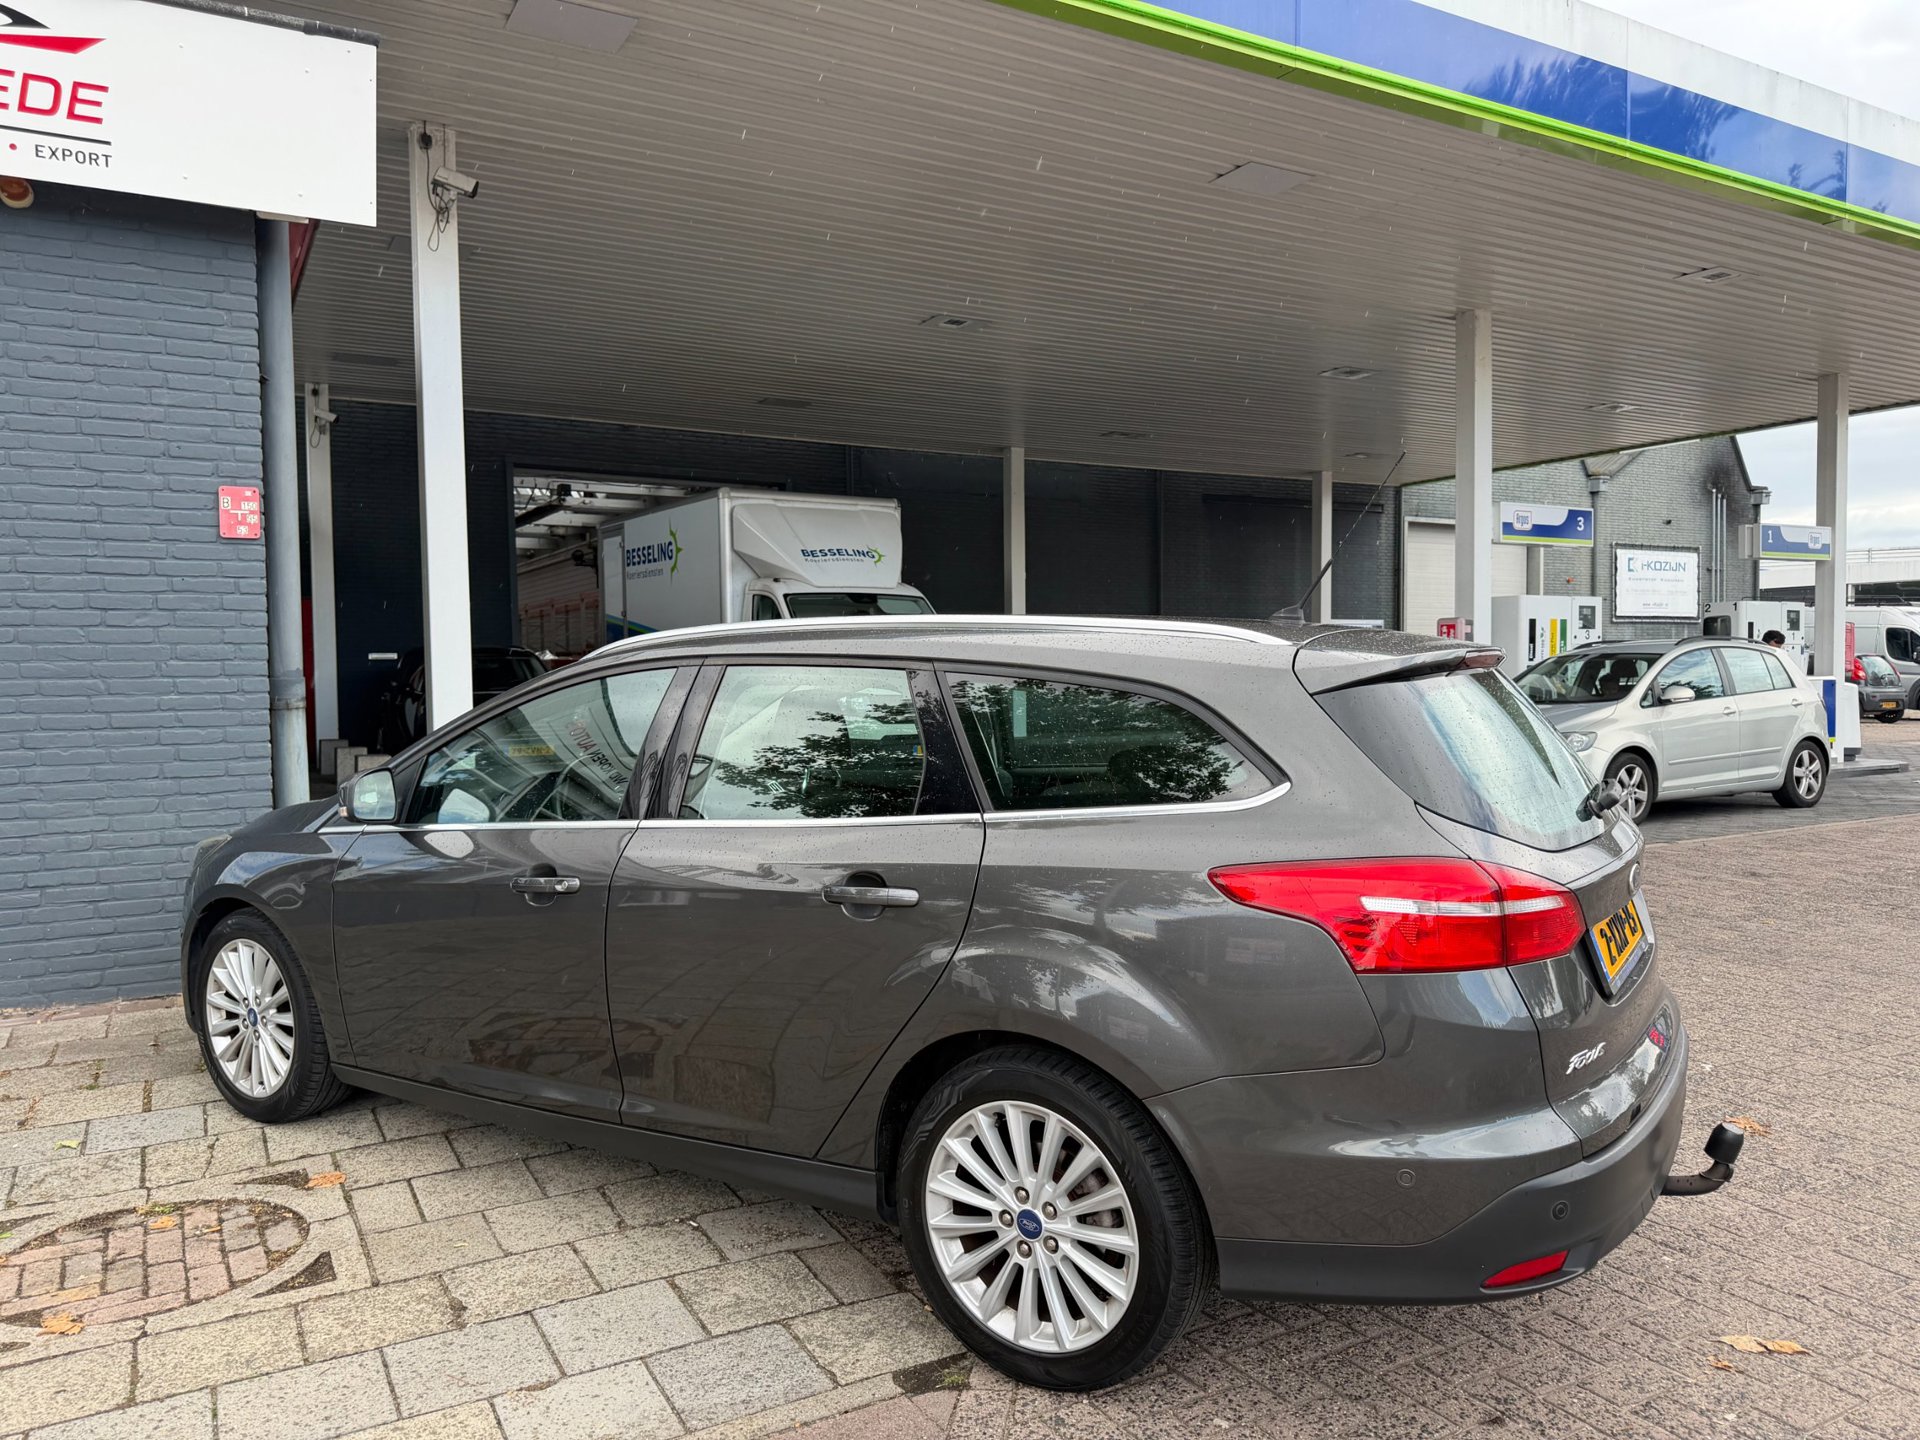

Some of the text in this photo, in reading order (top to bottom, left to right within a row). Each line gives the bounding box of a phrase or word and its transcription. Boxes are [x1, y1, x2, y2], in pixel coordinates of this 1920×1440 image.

[34, 144, 112, 168] EXPORT
[222, 497, 230, 508] B
[1576, 516, 1585, 531] 3
[1767, 529, 1774, 543] 1
[626, 540, 674, 568] BESSELING
[801, 548, 876, 560] BESSELING
[1705, 603, 1711, 613] 2
[1733, 602, 1738, 611] 1
[1584, 629, 1591, 640] 3
